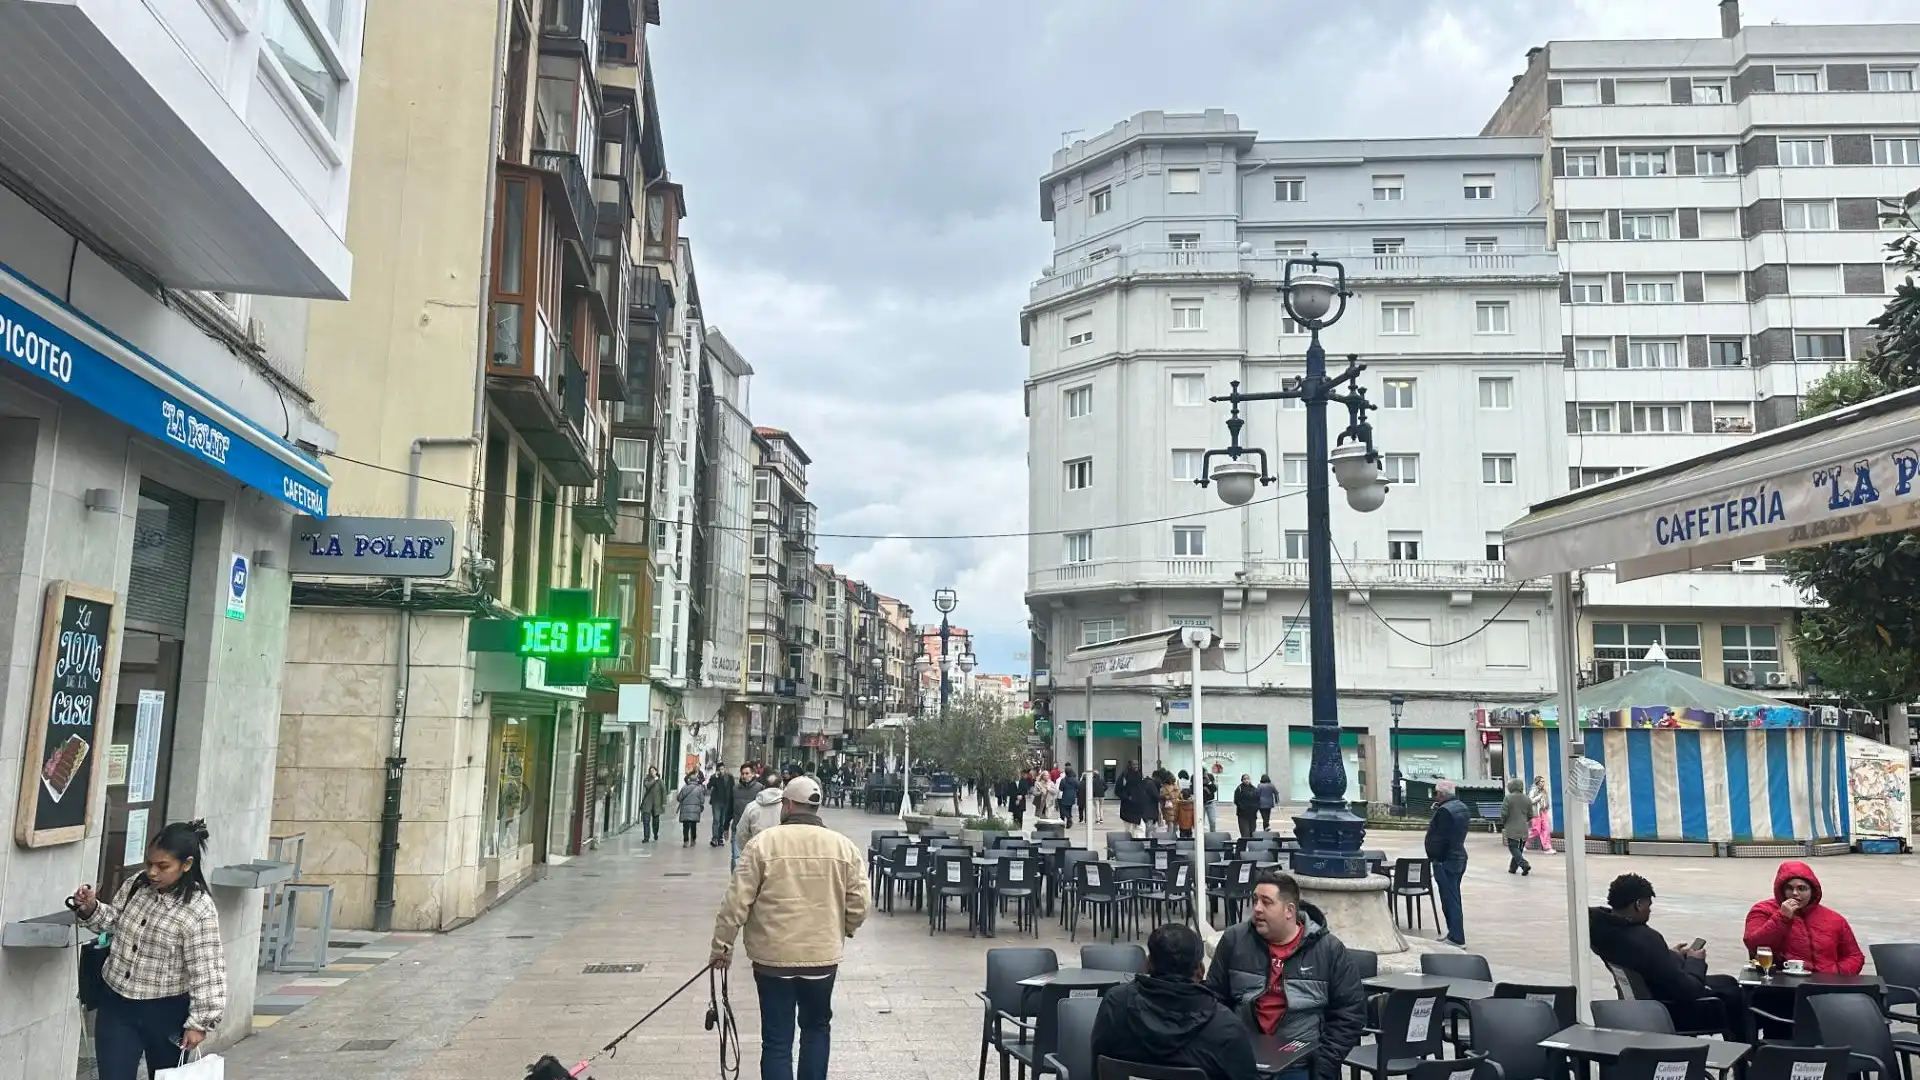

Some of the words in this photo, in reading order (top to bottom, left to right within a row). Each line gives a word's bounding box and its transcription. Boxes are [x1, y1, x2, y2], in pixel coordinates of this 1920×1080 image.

[283, 475, 324, 517] CAFETERÍA
[1656, 484, 1786, 546] CAFETERÍA
[1891, 448, 1920, 497] P
[576, 622, 611, 653] DE
